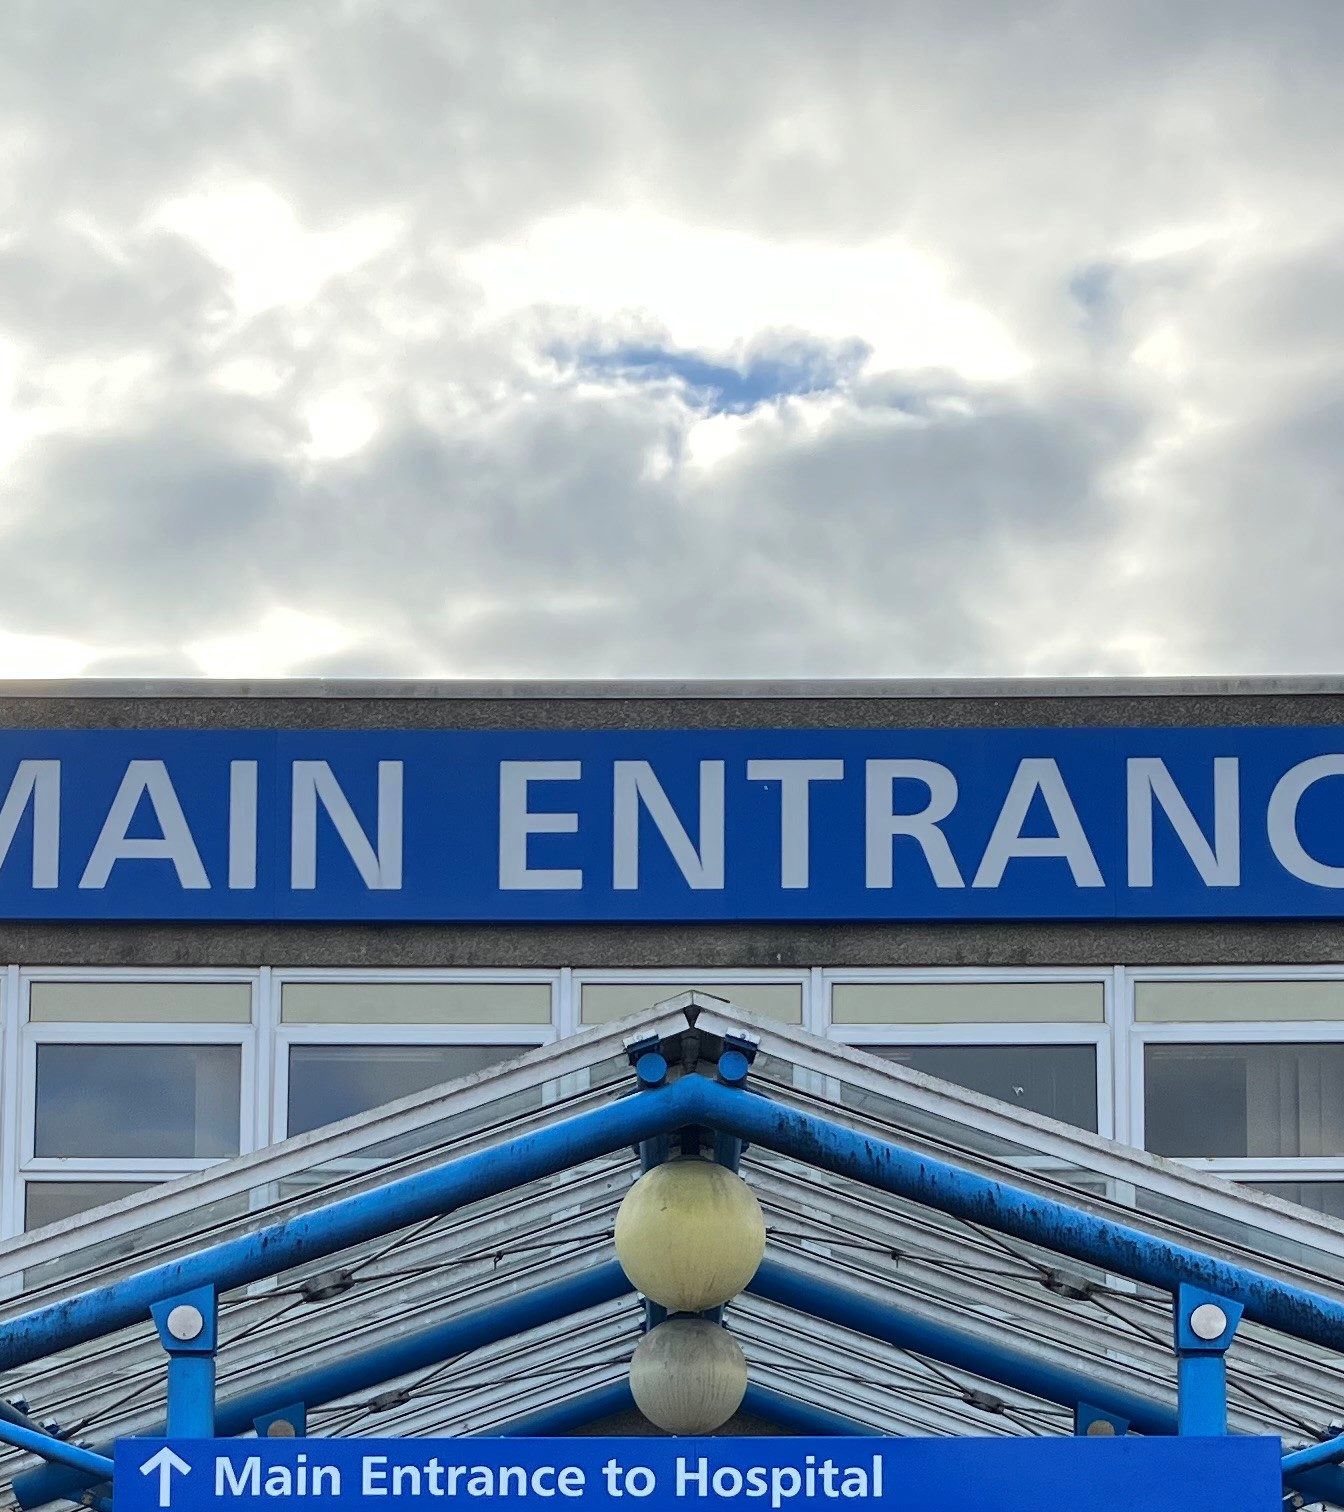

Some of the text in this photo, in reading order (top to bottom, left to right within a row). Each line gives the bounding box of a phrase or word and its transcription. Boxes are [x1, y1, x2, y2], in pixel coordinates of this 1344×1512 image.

[216, 1455, 882, 1507] Main Entrance to Hospital
